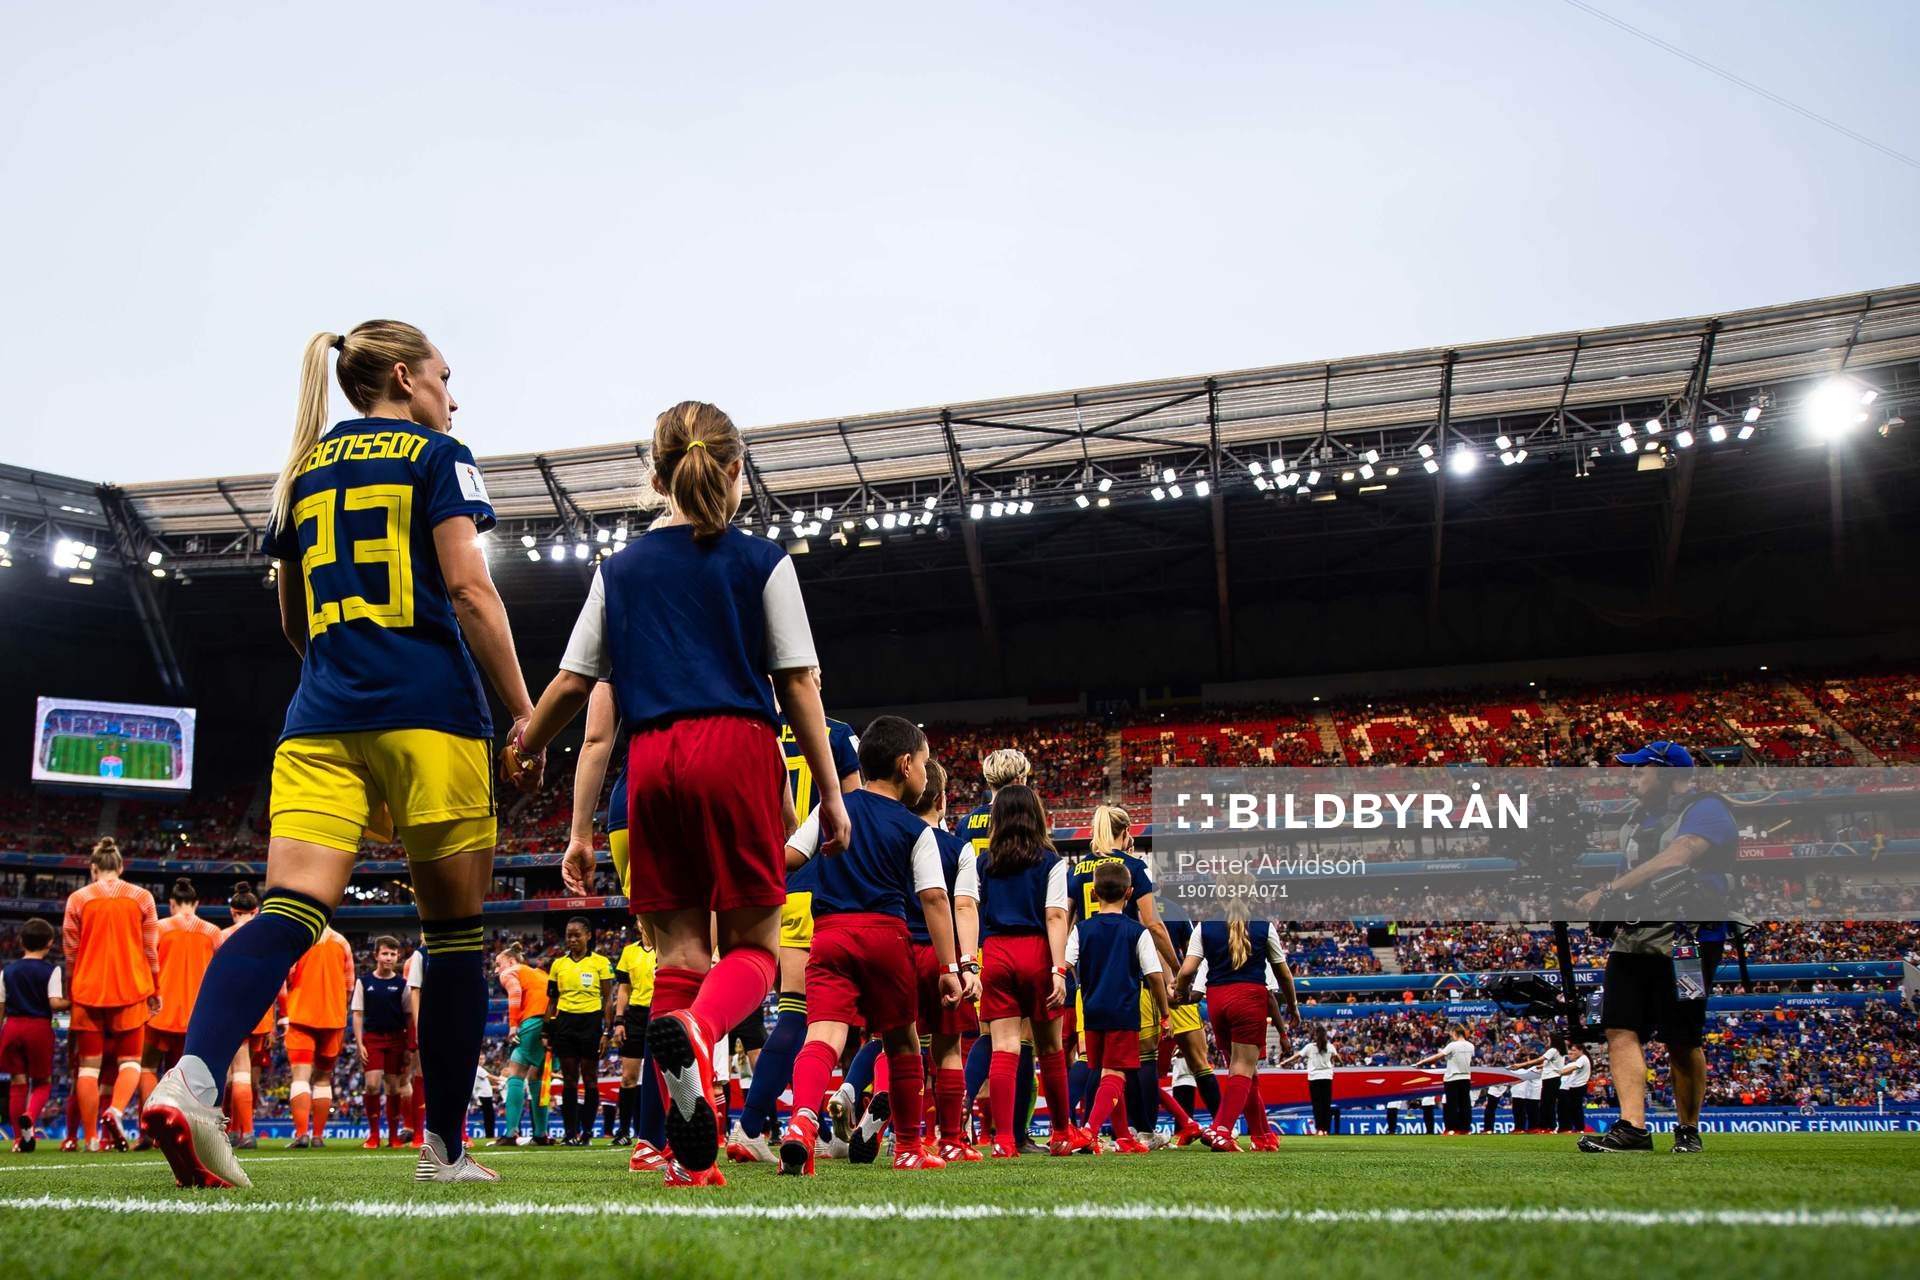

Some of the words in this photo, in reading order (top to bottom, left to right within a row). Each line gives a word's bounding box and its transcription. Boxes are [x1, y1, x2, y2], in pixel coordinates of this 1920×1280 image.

[298, 432, 429, 475] BENSSON
[292, 484, 413, 640] 23
[1739, 848, 1765, 858] LYON
[1698, 1120, 1724, 1133] DU
[1731, 1120, 1802, 1133] MONDE
